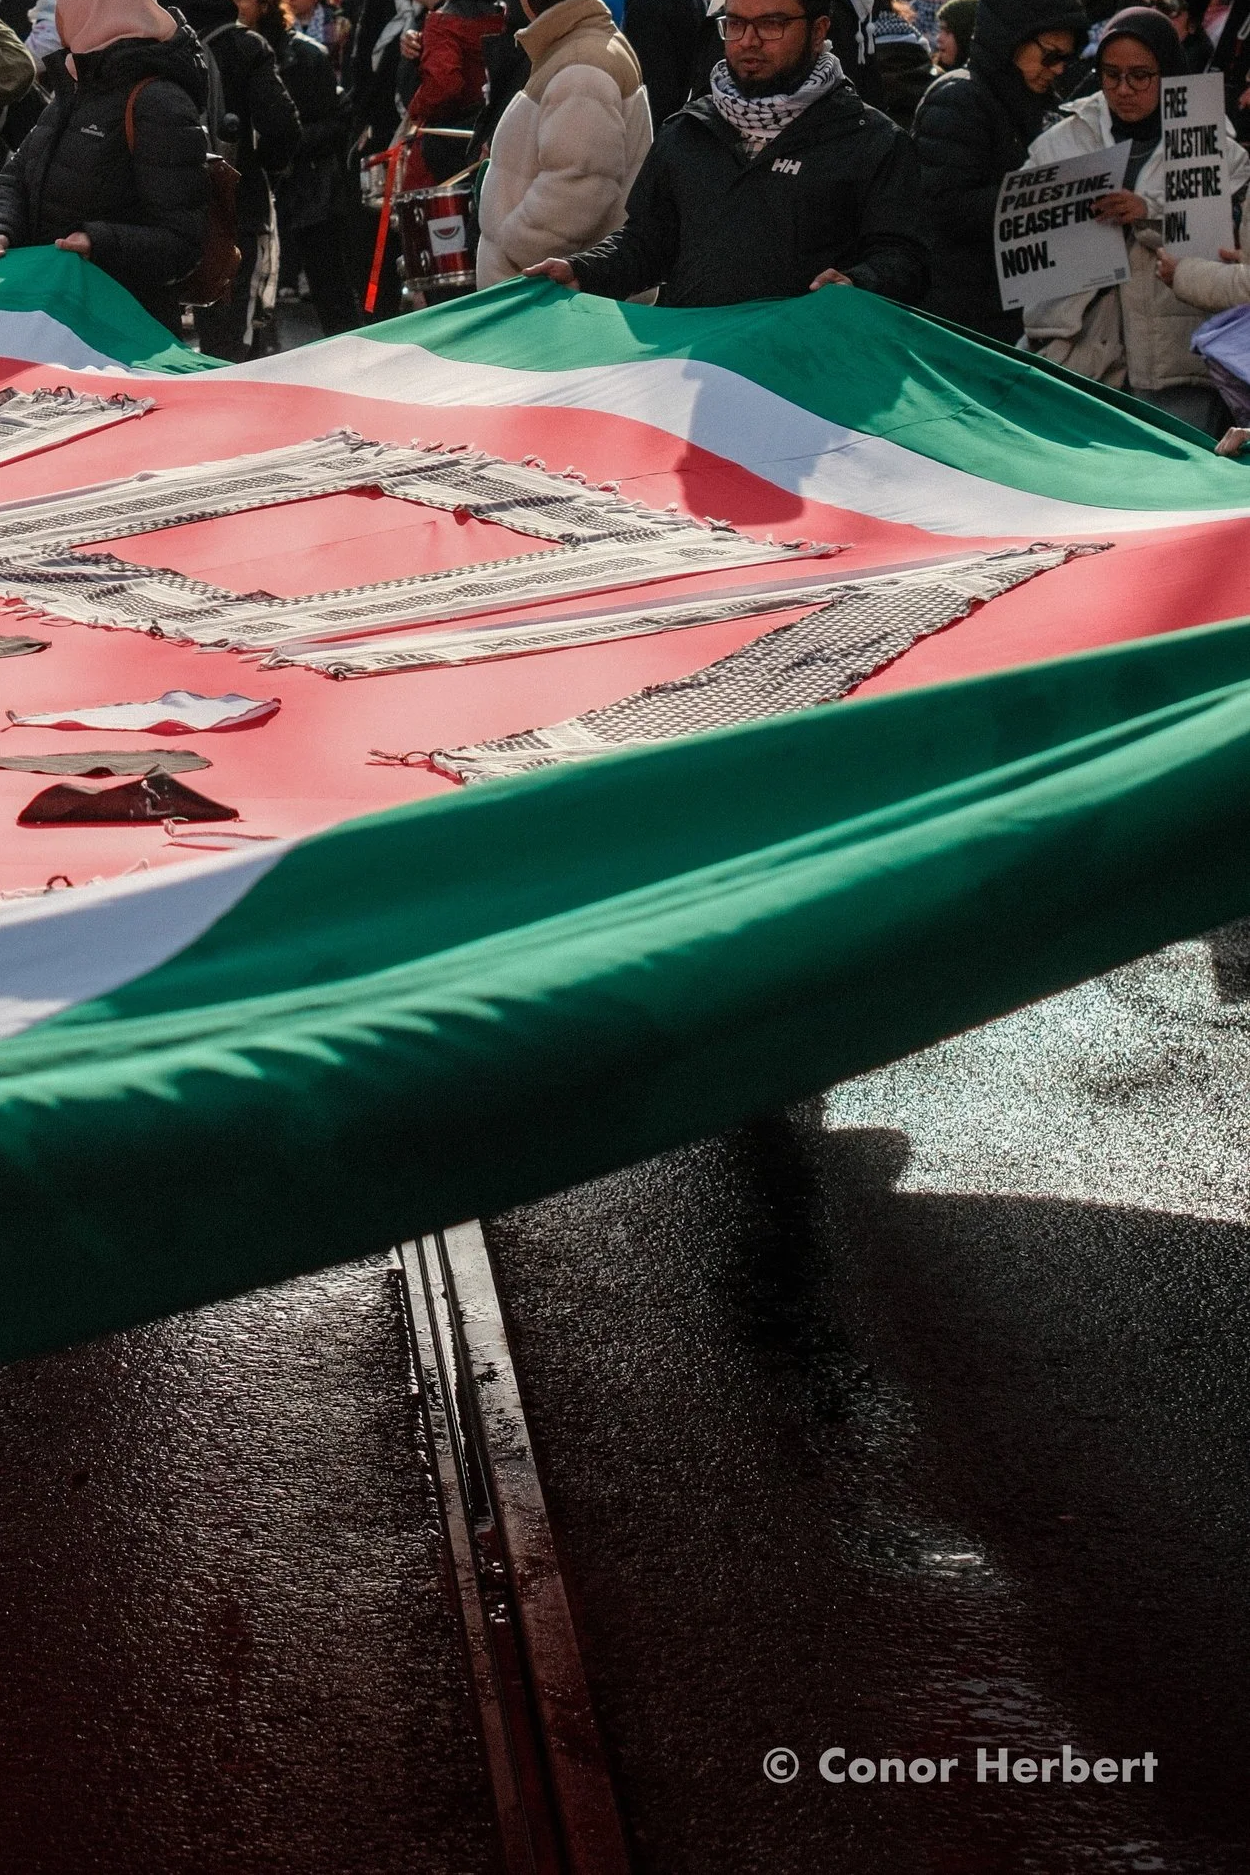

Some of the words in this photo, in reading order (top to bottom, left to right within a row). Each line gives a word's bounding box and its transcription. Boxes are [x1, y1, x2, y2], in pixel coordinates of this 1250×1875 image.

[1163, 86, 1188, 120] FREE
[771, 158, 802, 175] HH
[1005, 166, 1060, 192] FREE
[1165, 165, 1222, 203] CEASEFIRE
[1000, 240, 1056, 279] NOW.
